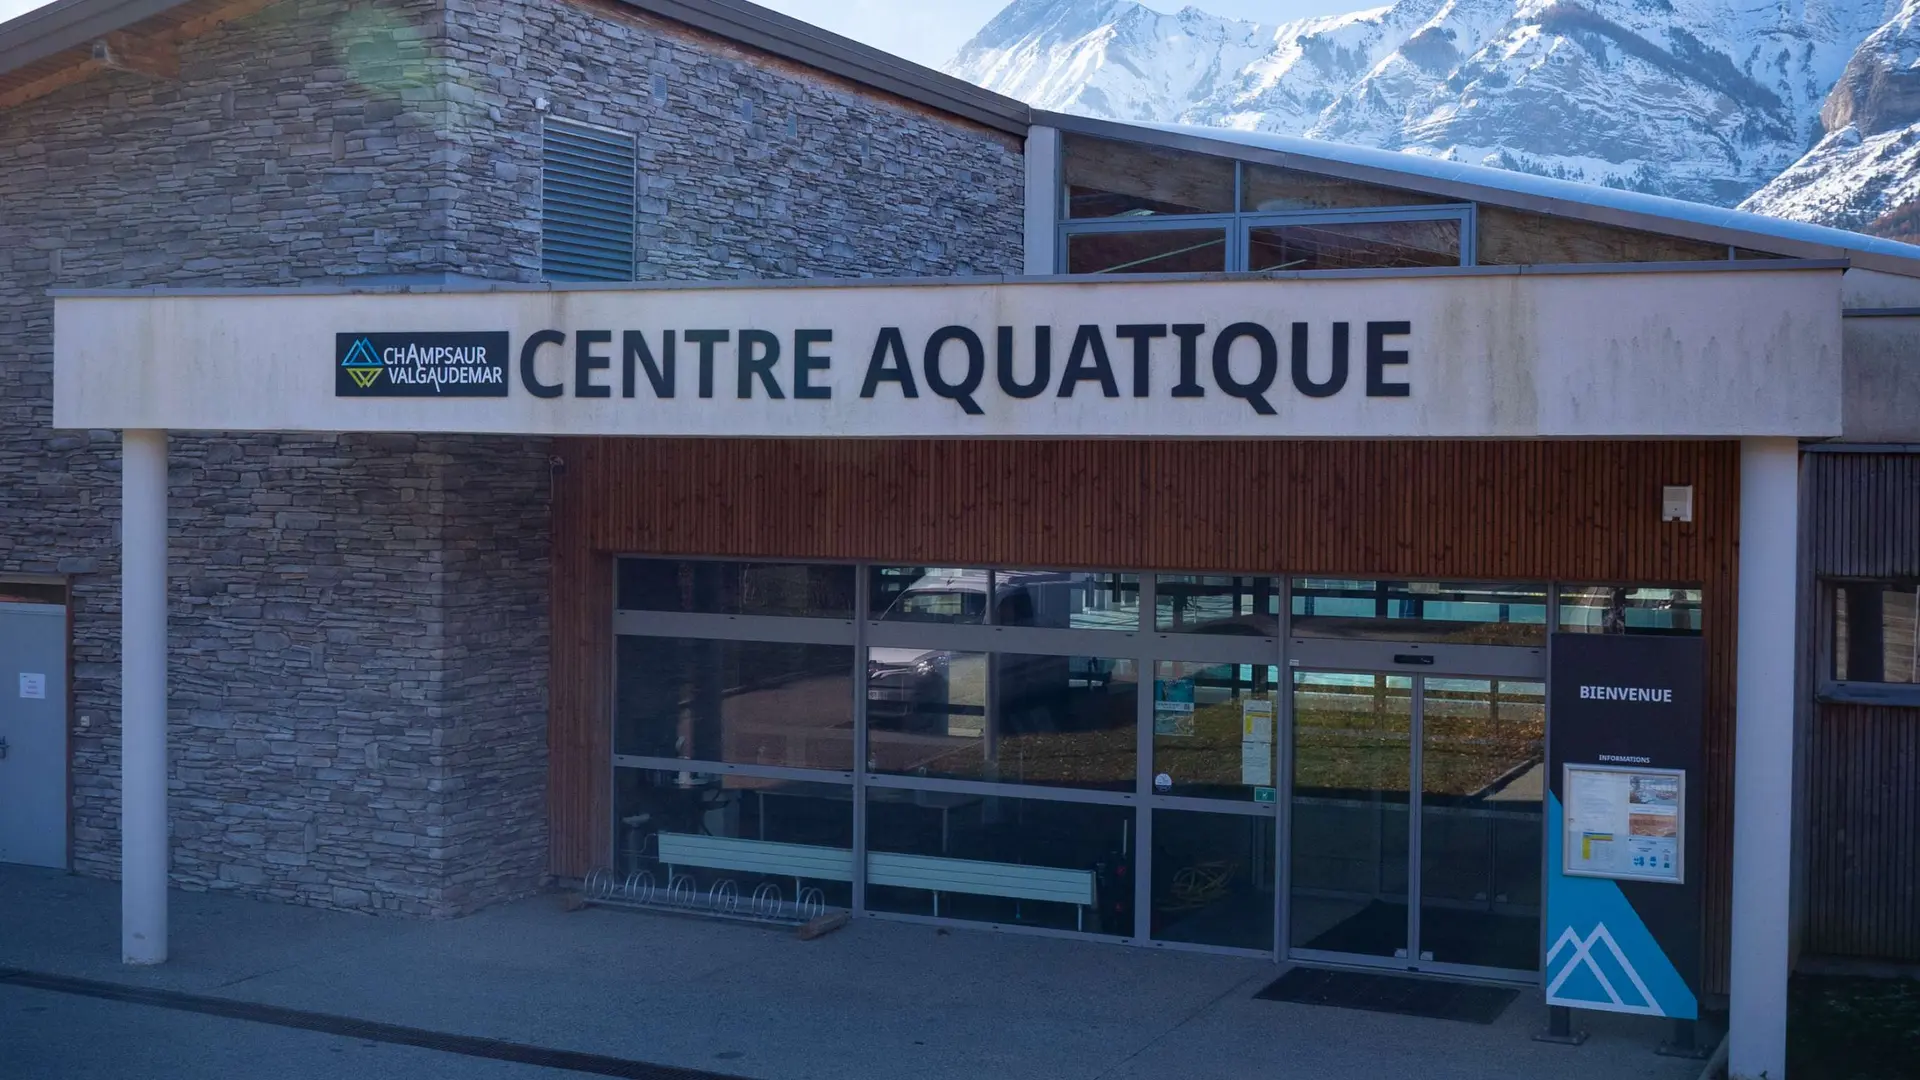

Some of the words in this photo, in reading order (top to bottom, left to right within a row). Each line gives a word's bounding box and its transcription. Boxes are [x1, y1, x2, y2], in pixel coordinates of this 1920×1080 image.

[384, 343, 487, 369] CHAMPSAUR
[520, 329, 833, 399] CENTRE
[859, 321, 1411, 415] AQUATIQUE
[388, 366, 503, 392] VALGAUDEMAR
[1580, 685, 1672, 702] BIENVENUE
[1598, 754, 1650, 764] INFORMATIONS
